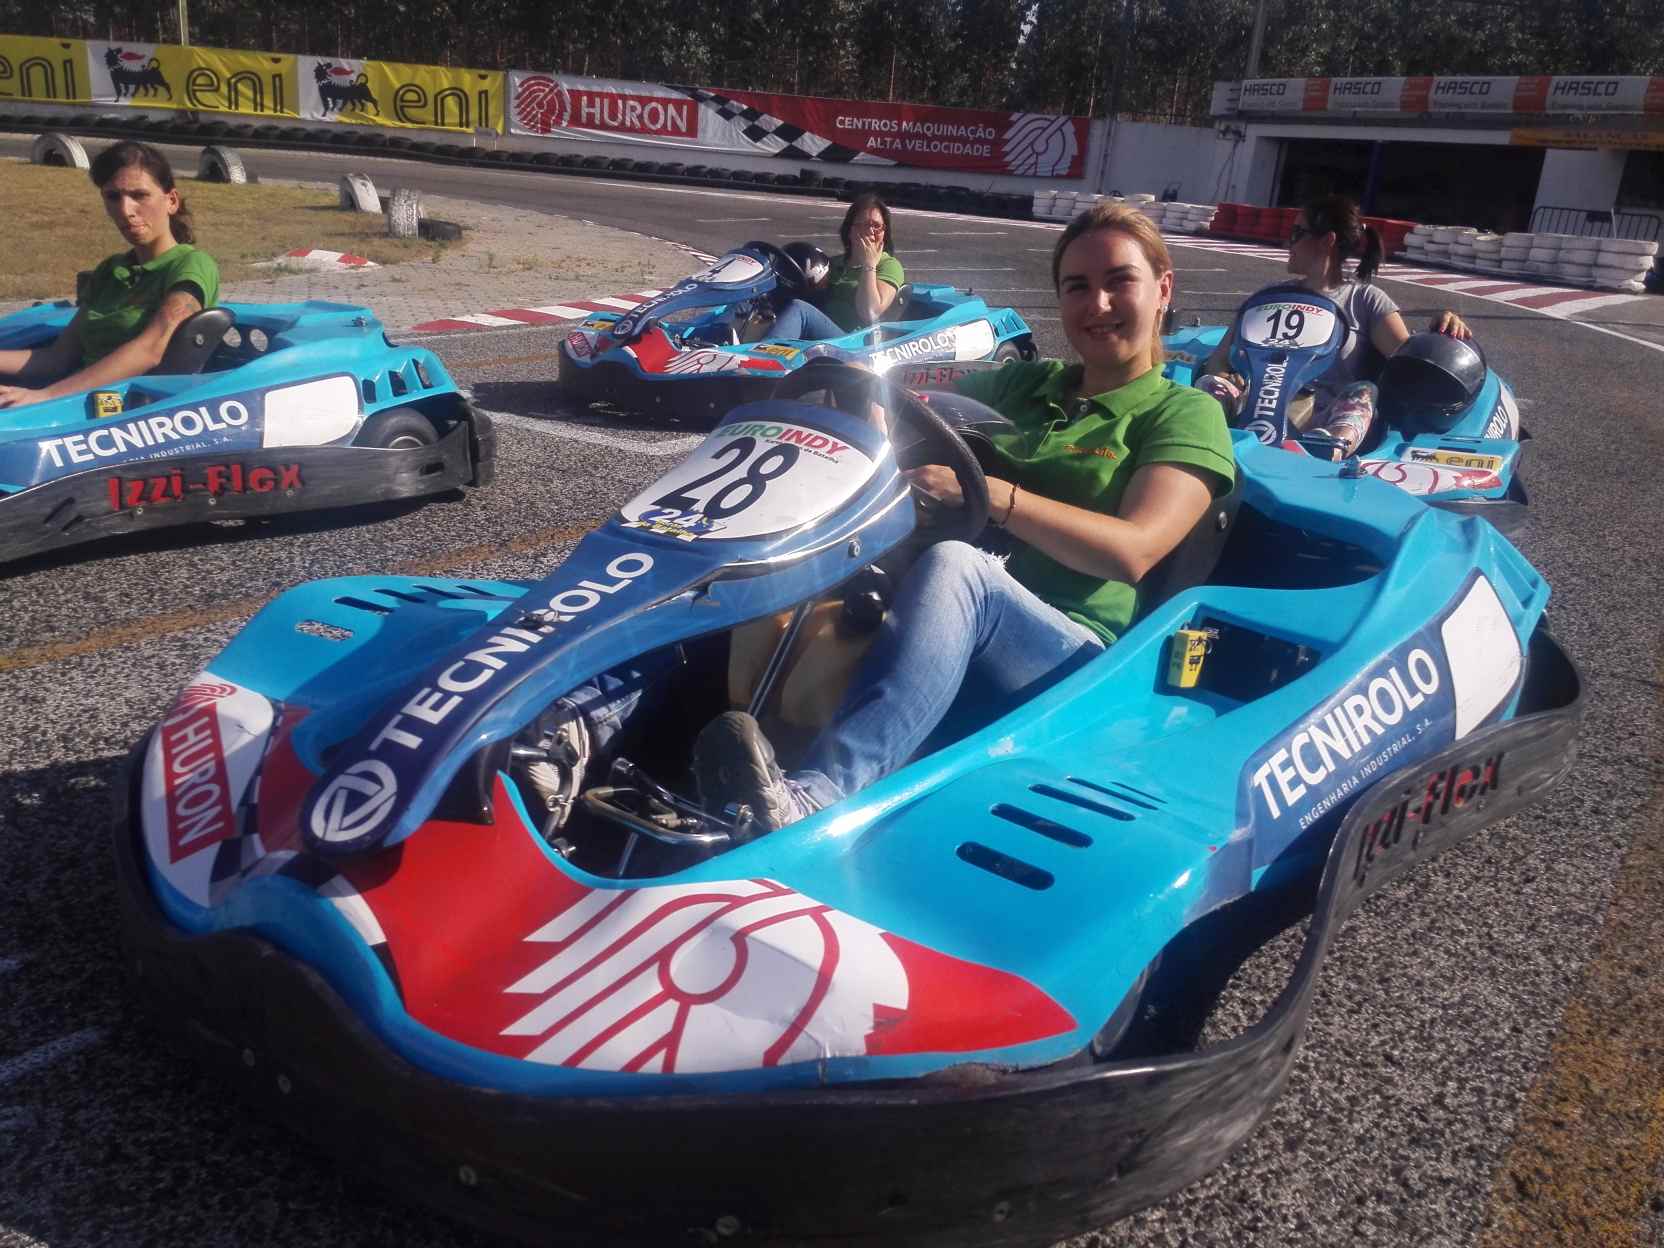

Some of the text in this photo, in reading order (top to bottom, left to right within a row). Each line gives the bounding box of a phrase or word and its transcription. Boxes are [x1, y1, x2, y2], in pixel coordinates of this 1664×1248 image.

[186, 57, 284, 113] eni
[394, 74, 489, 127] eni
[1243, 83, 1287, 96] HASCO
[1333, 81, 1382, 95] HASCO
[1435, 81, 1492, 95] HASCO
[1553, 81, 1620, 96] HASCO
[581, 95, 688, 132] HURON
[836, 116, 995, 140] CENTROS MAQUINAÇÃO
[866, 136, 991, 157] ALTA VELOCIDADE
[1266, 309, 1305, 340] 19
[1254, 355, 1289, 419] TECNIROL
[39, 400, 249, 468] TECNIROLO
[715, 424, 849, 454] EUROINDY
[651, 437, 800, 520] 28
[1446, 456, 1494, 470] eni
[1253, 648, 1439, 820] TECNIROLO
[170, 716, 224, 848] HURON
[1300, 775, 1360, 830] ENGENHARIA
